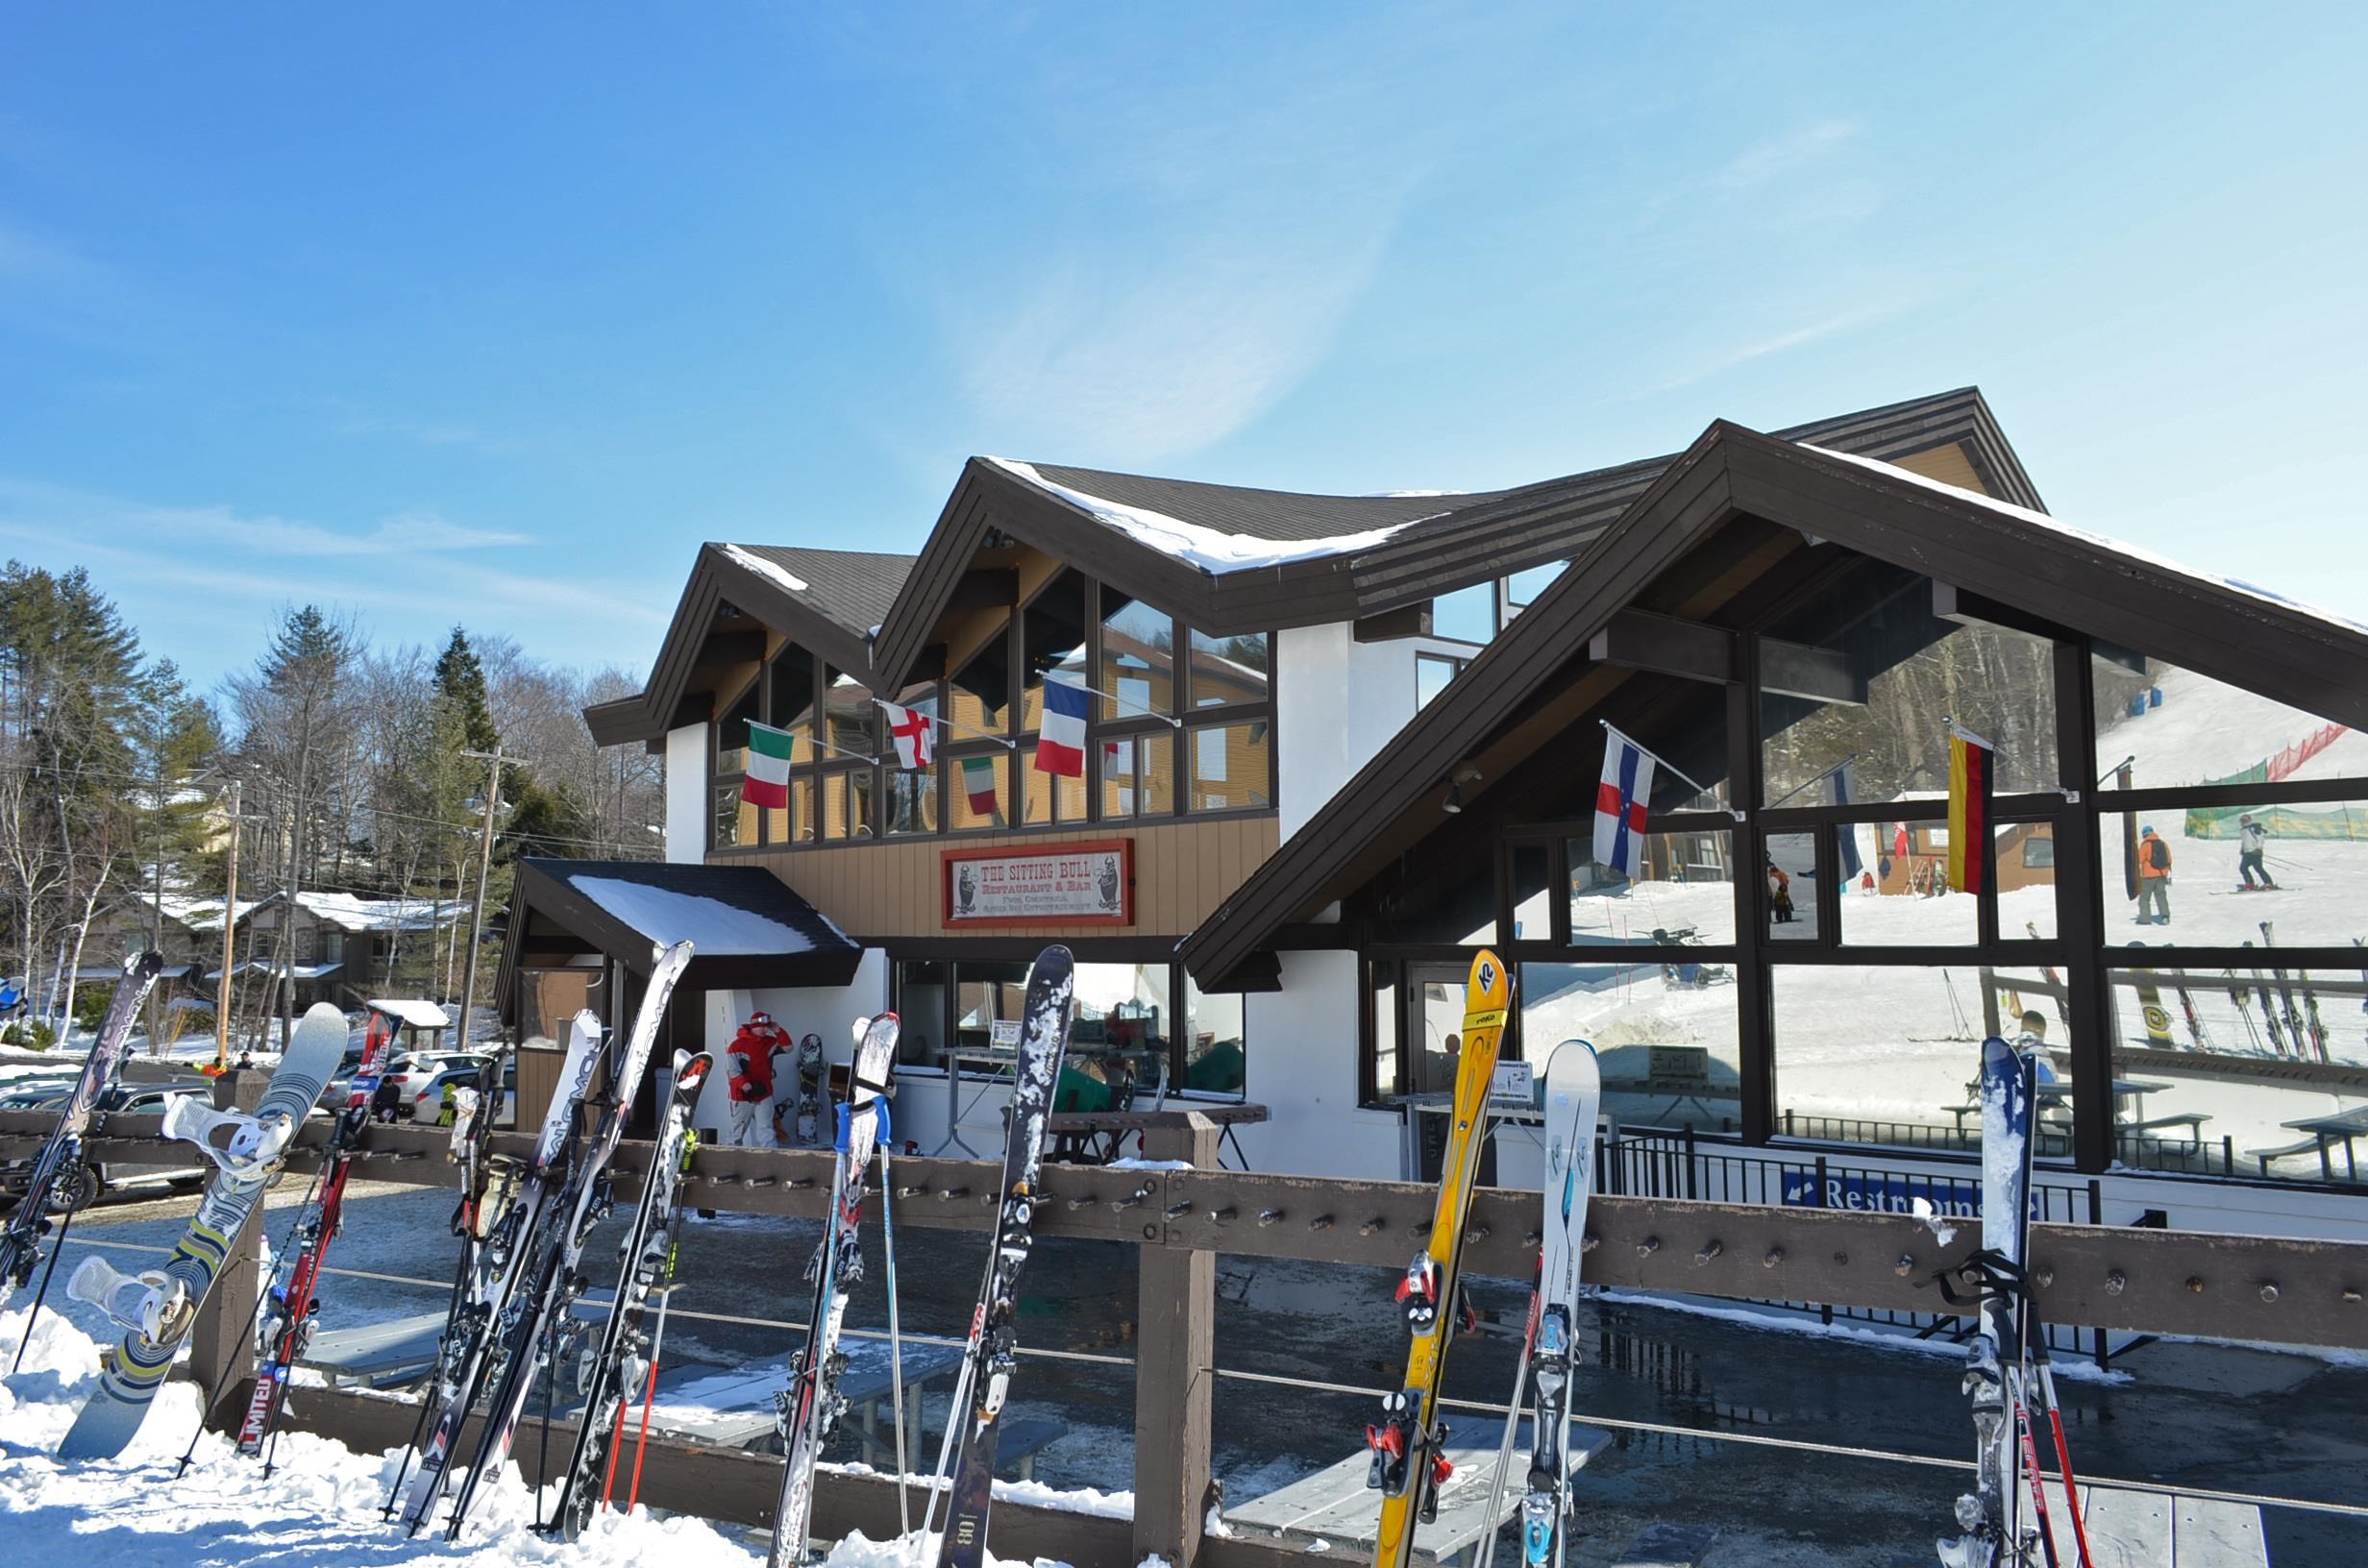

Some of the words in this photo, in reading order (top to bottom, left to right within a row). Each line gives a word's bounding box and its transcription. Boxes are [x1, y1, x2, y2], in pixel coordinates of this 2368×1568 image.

[981, 866, 1004, 882] THE
[1009, 863, 1053, 881] SITTING
[1059, 861, 1091, 878] BULL
[1055, 882, 1063, 892] &
[1067, 880, 1092, 892] BAR
[1478, 963, 1494, 992] K2
[1826, 1180, 1985, 1217] Restrms
[956, 1521, 975, 1546] 80
